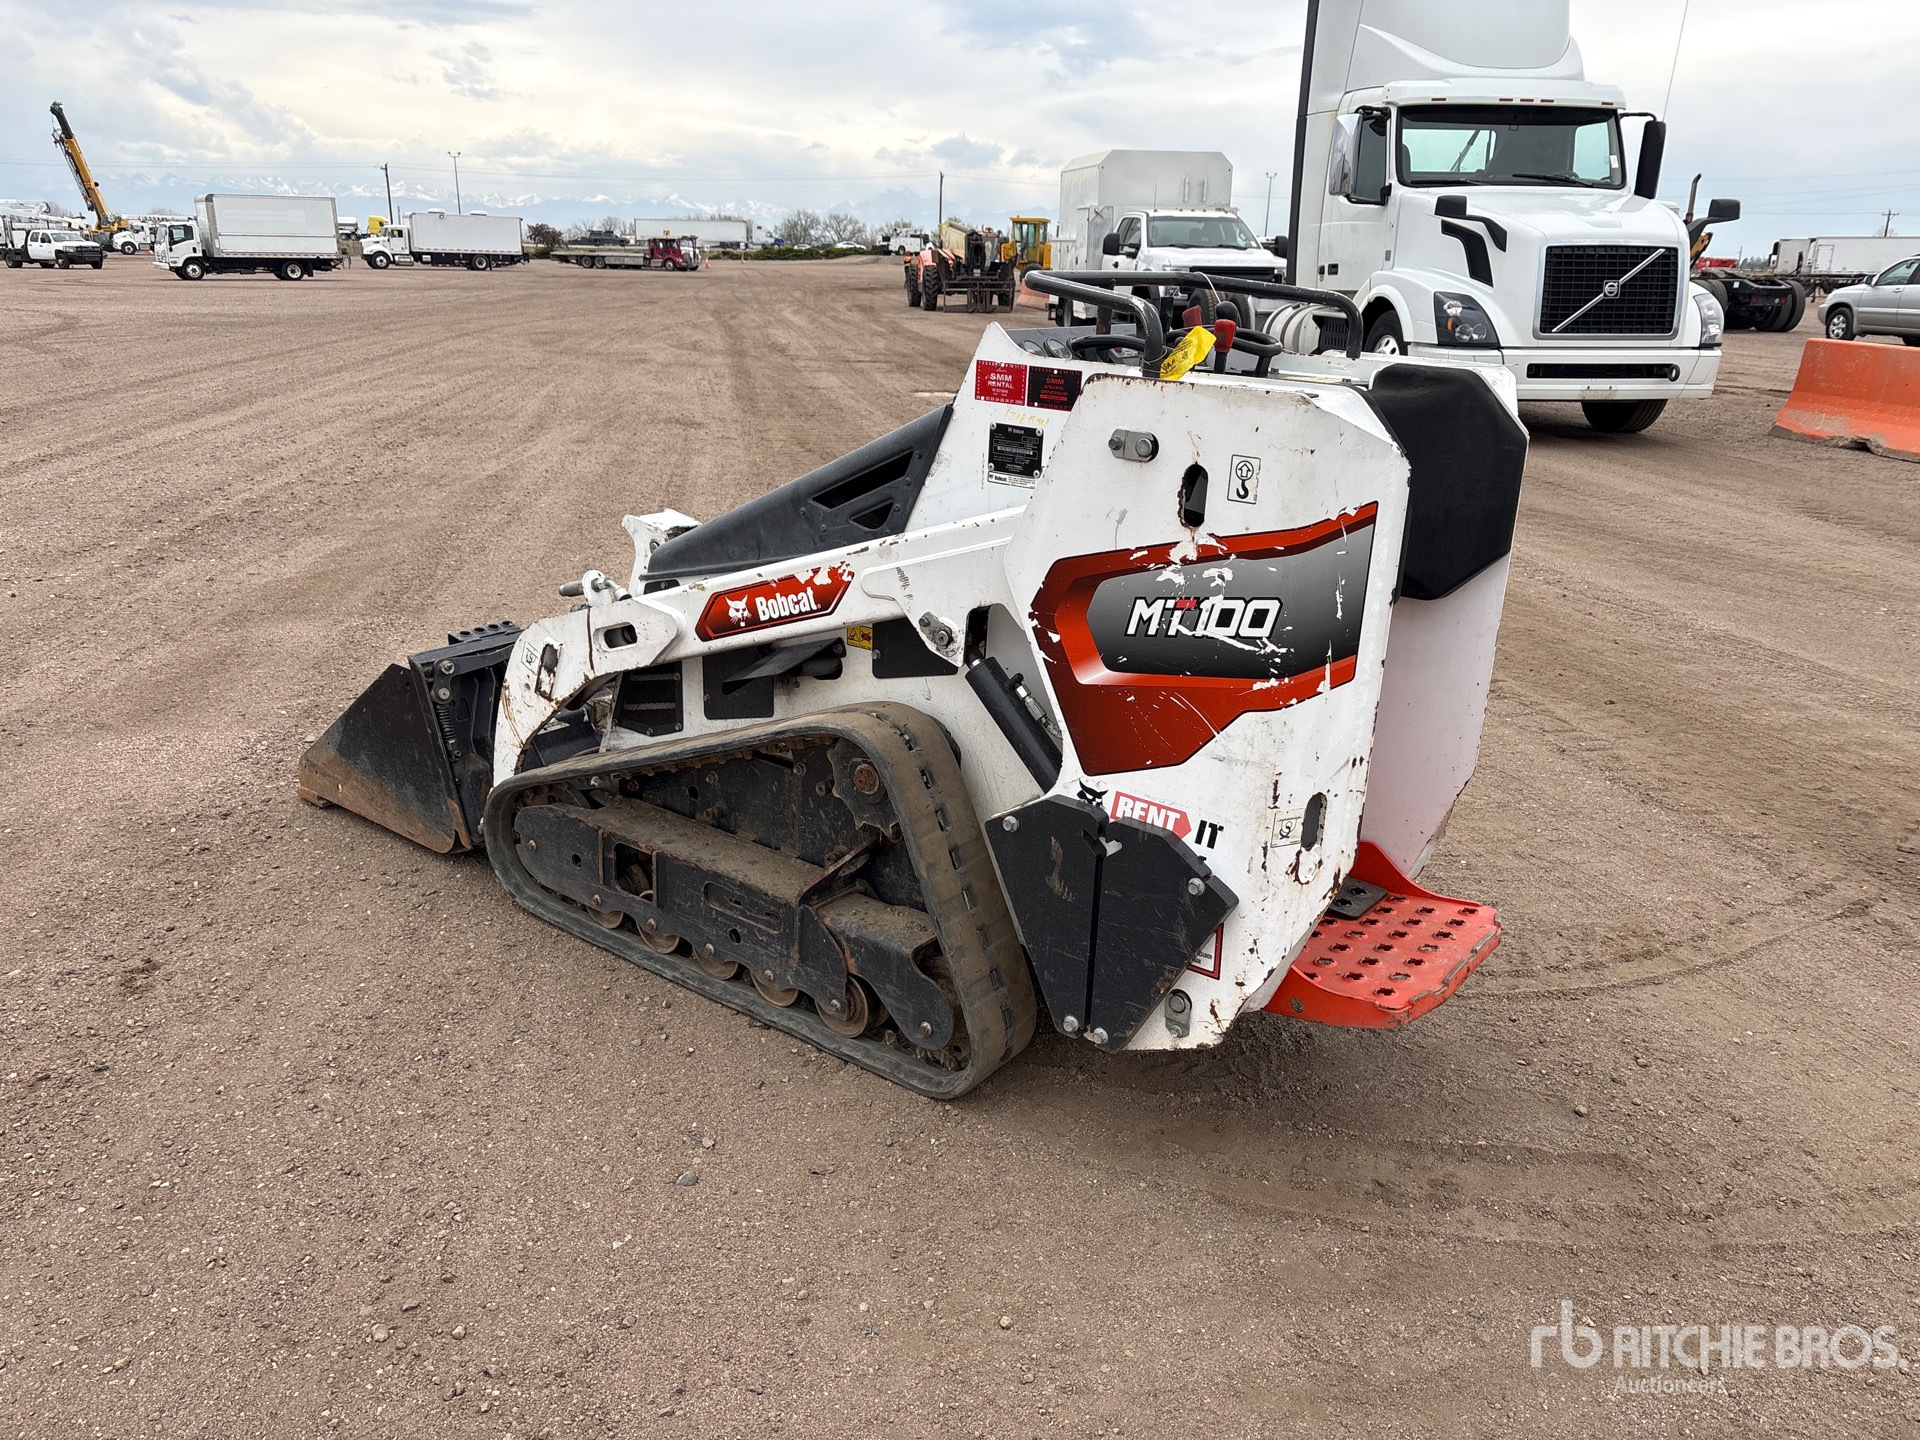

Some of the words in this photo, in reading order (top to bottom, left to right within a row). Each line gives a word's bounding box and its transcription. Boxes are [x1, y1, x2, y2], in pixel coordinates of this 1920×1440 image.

[990, 372, 1013, 382] SMM
[1045, 377, 1065, 385] SMM
[987, 380, 1014, 389] RENTAL
[755, 586, 818, 622] Bobcat
[1116, 795, 1181, 832] RENT
[1194, 819, 1224, 849] IT
